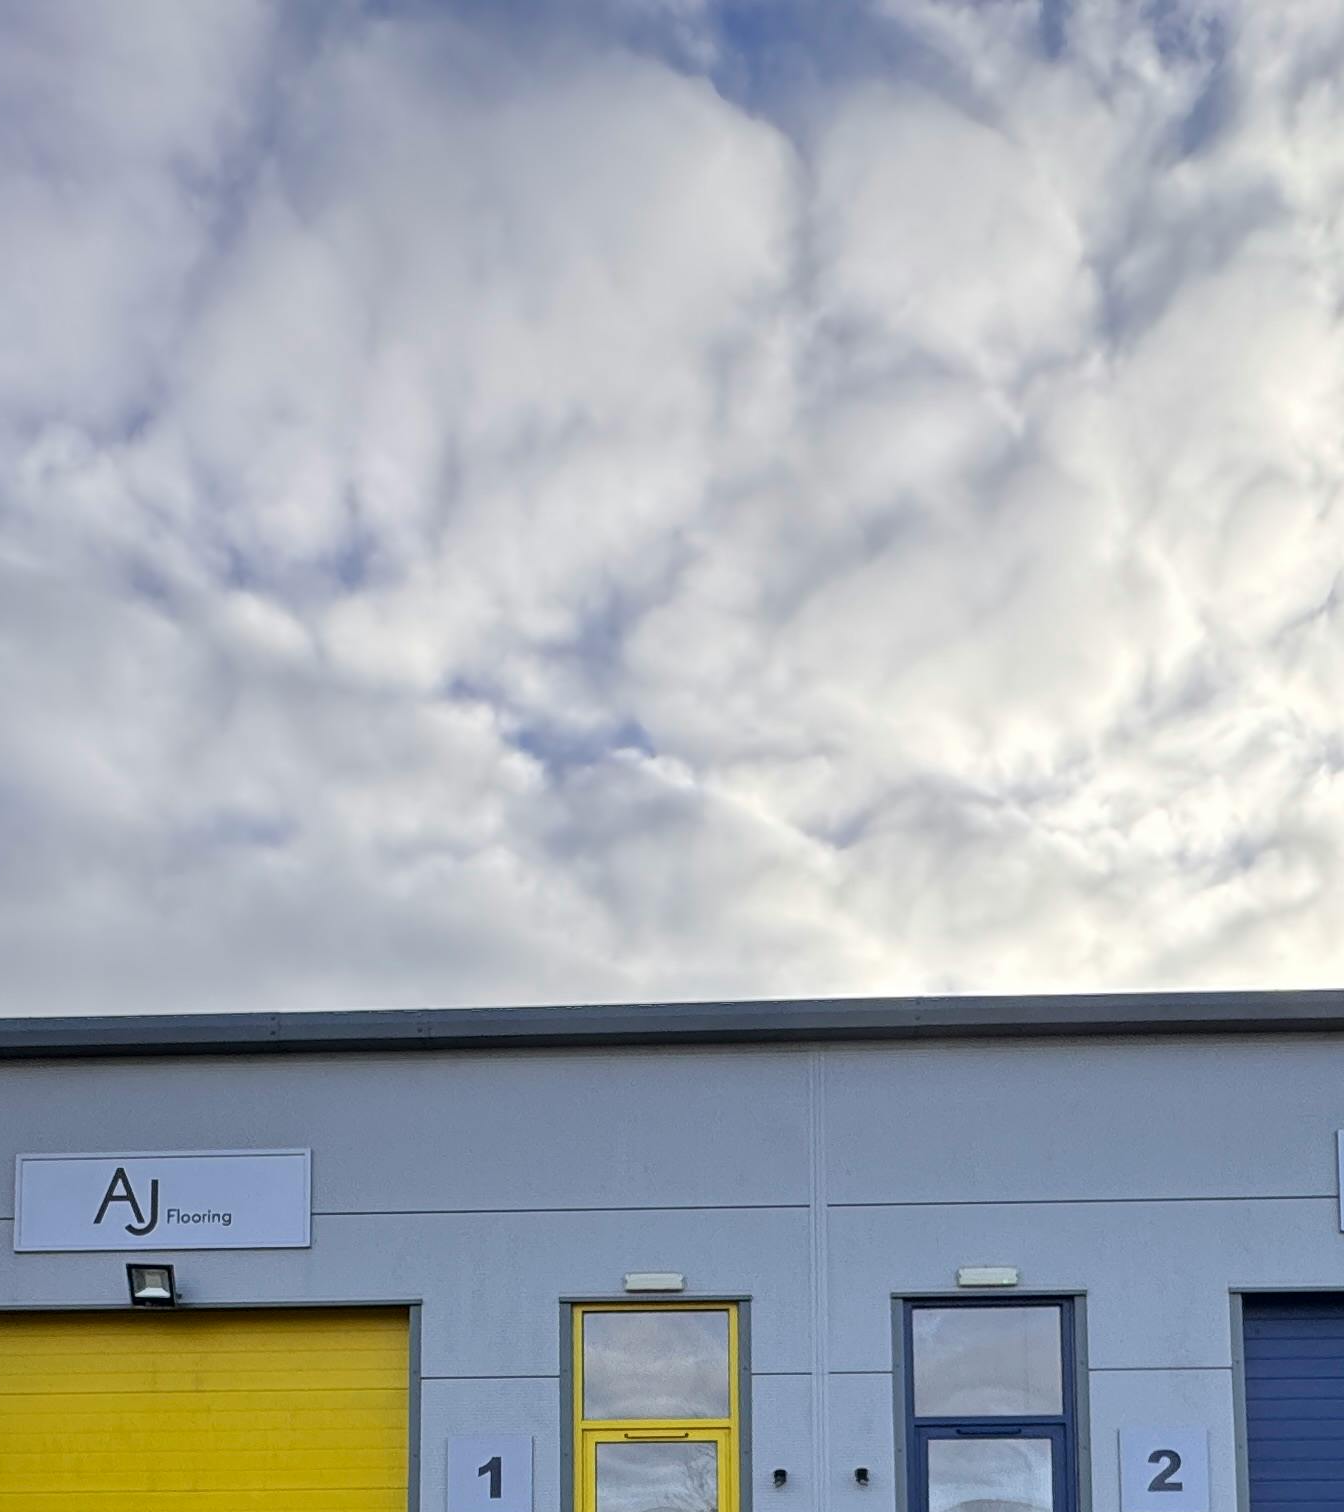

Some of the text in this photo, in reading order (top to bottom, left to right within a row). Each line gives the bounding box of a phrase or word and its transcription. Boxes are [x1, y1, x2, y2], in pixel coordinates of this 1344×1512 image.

[93, 1167, 232, 1236] AJ Flooring
[478, 1456, 502, 1499] 1
[1147, 1449, 1183, 1492] 2
